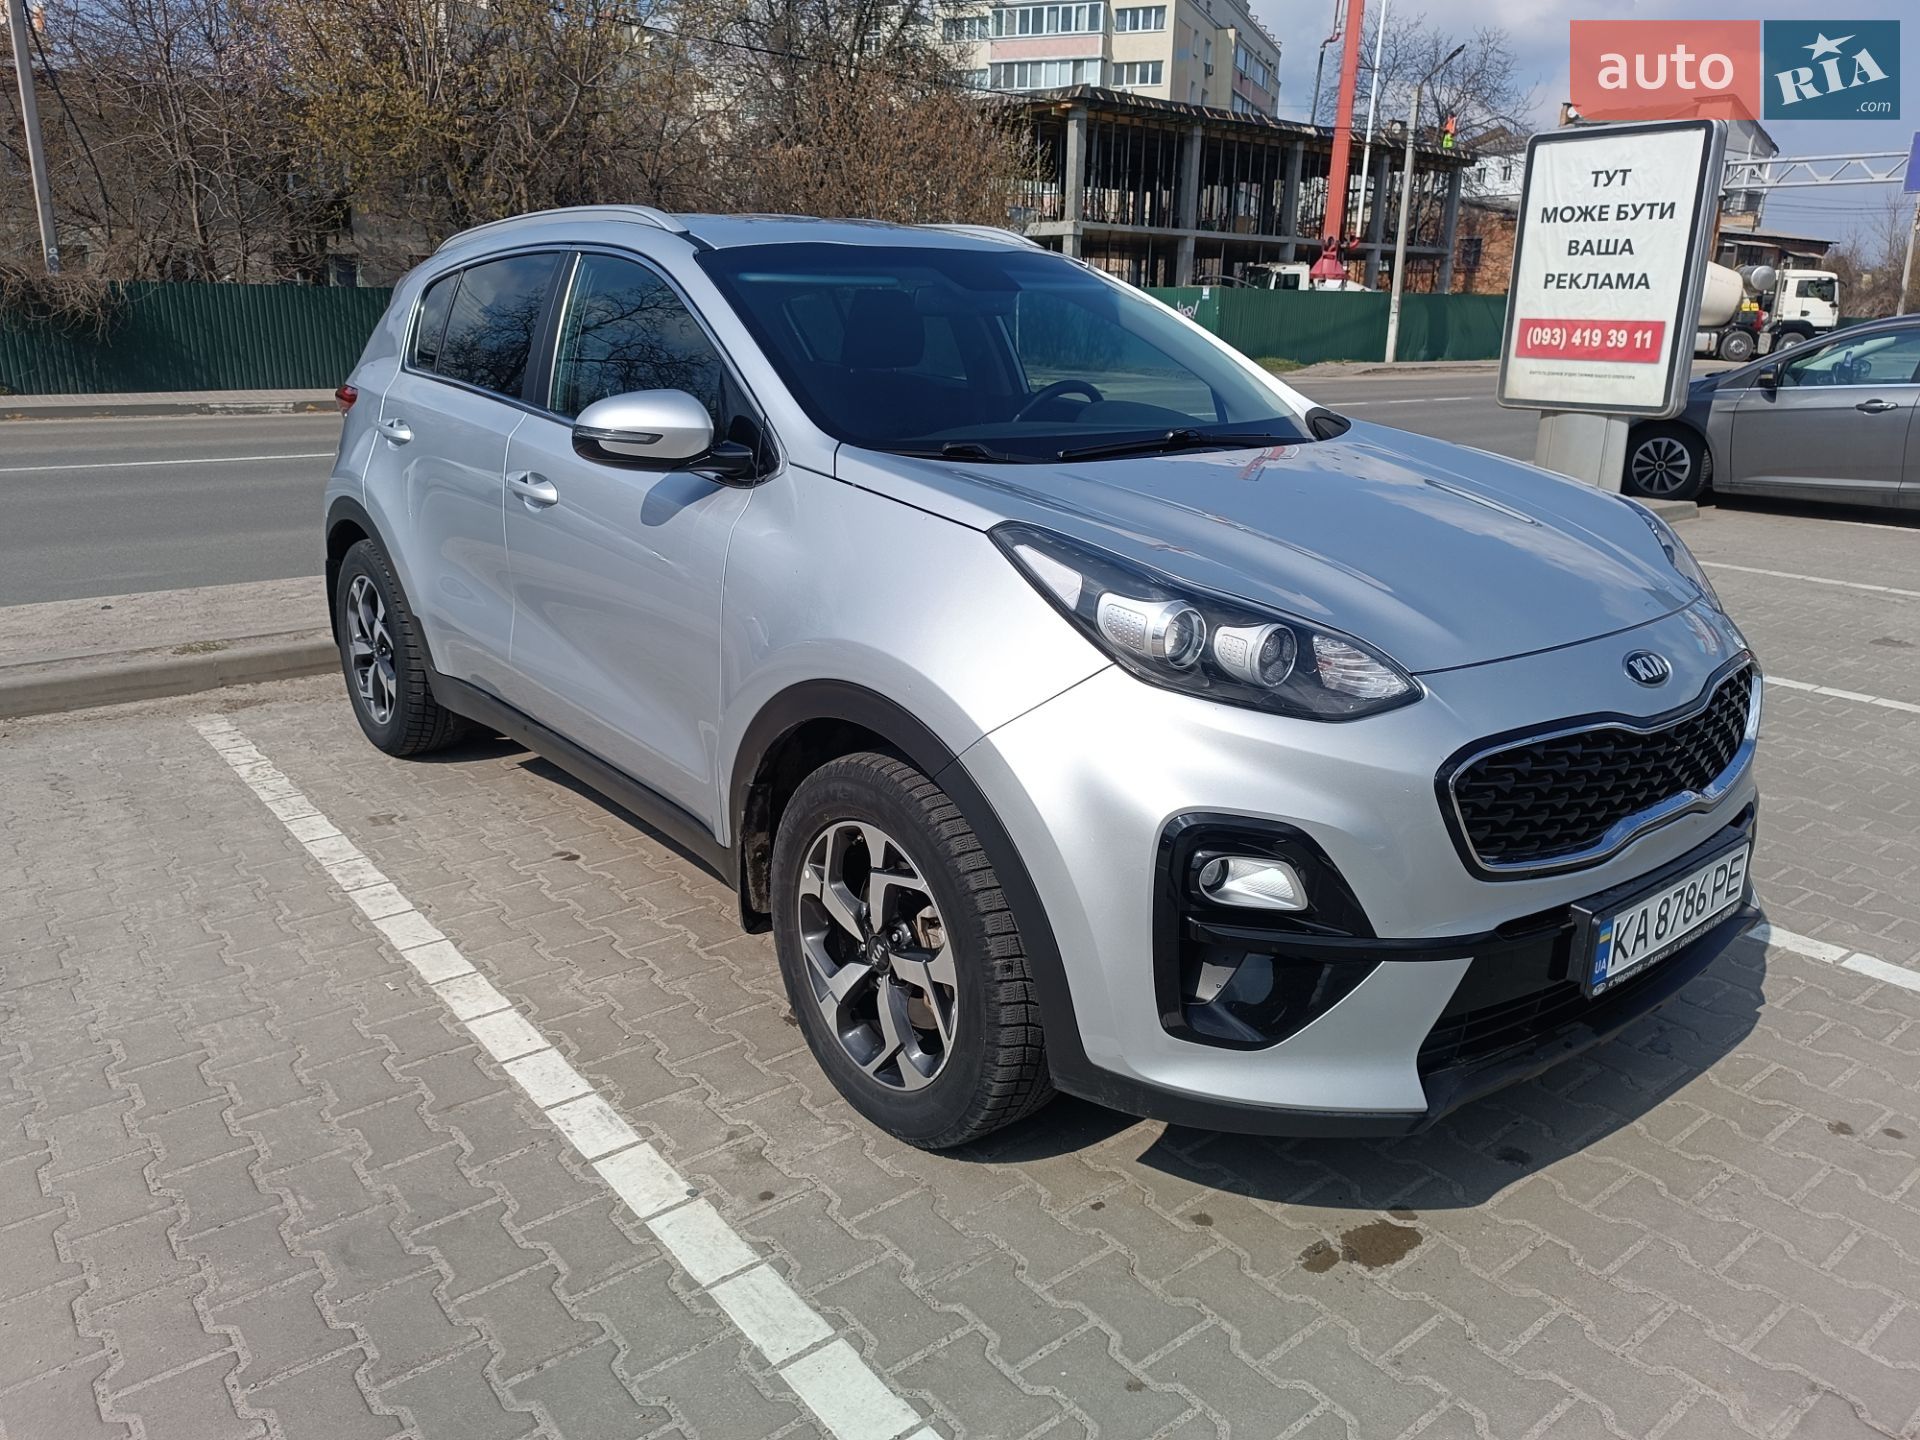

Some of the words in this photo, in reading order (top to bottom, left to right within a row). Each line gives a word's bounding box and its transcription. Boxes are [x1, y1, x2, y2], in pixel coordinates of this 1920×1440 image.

[1591, 168, 1632, 188] ТУТ
[1540, 204, 1609, 223] МОЖЕ
[1616, 202, 1676, 221] БУТИ
[1567, 238, 1634, 256] ВАША
[1543, 272, 1651, 290] РЕКЛАМА
[1526, 326, 1567, 350] (093)
[1571, 328, 1602, 347] 419
[1606, 329, 1627, 348] 39
[1633, 330, 1653, 349] 11
[1629, 655, 1667, 680] KIA
[1594, 957, 1607, 974] UA
